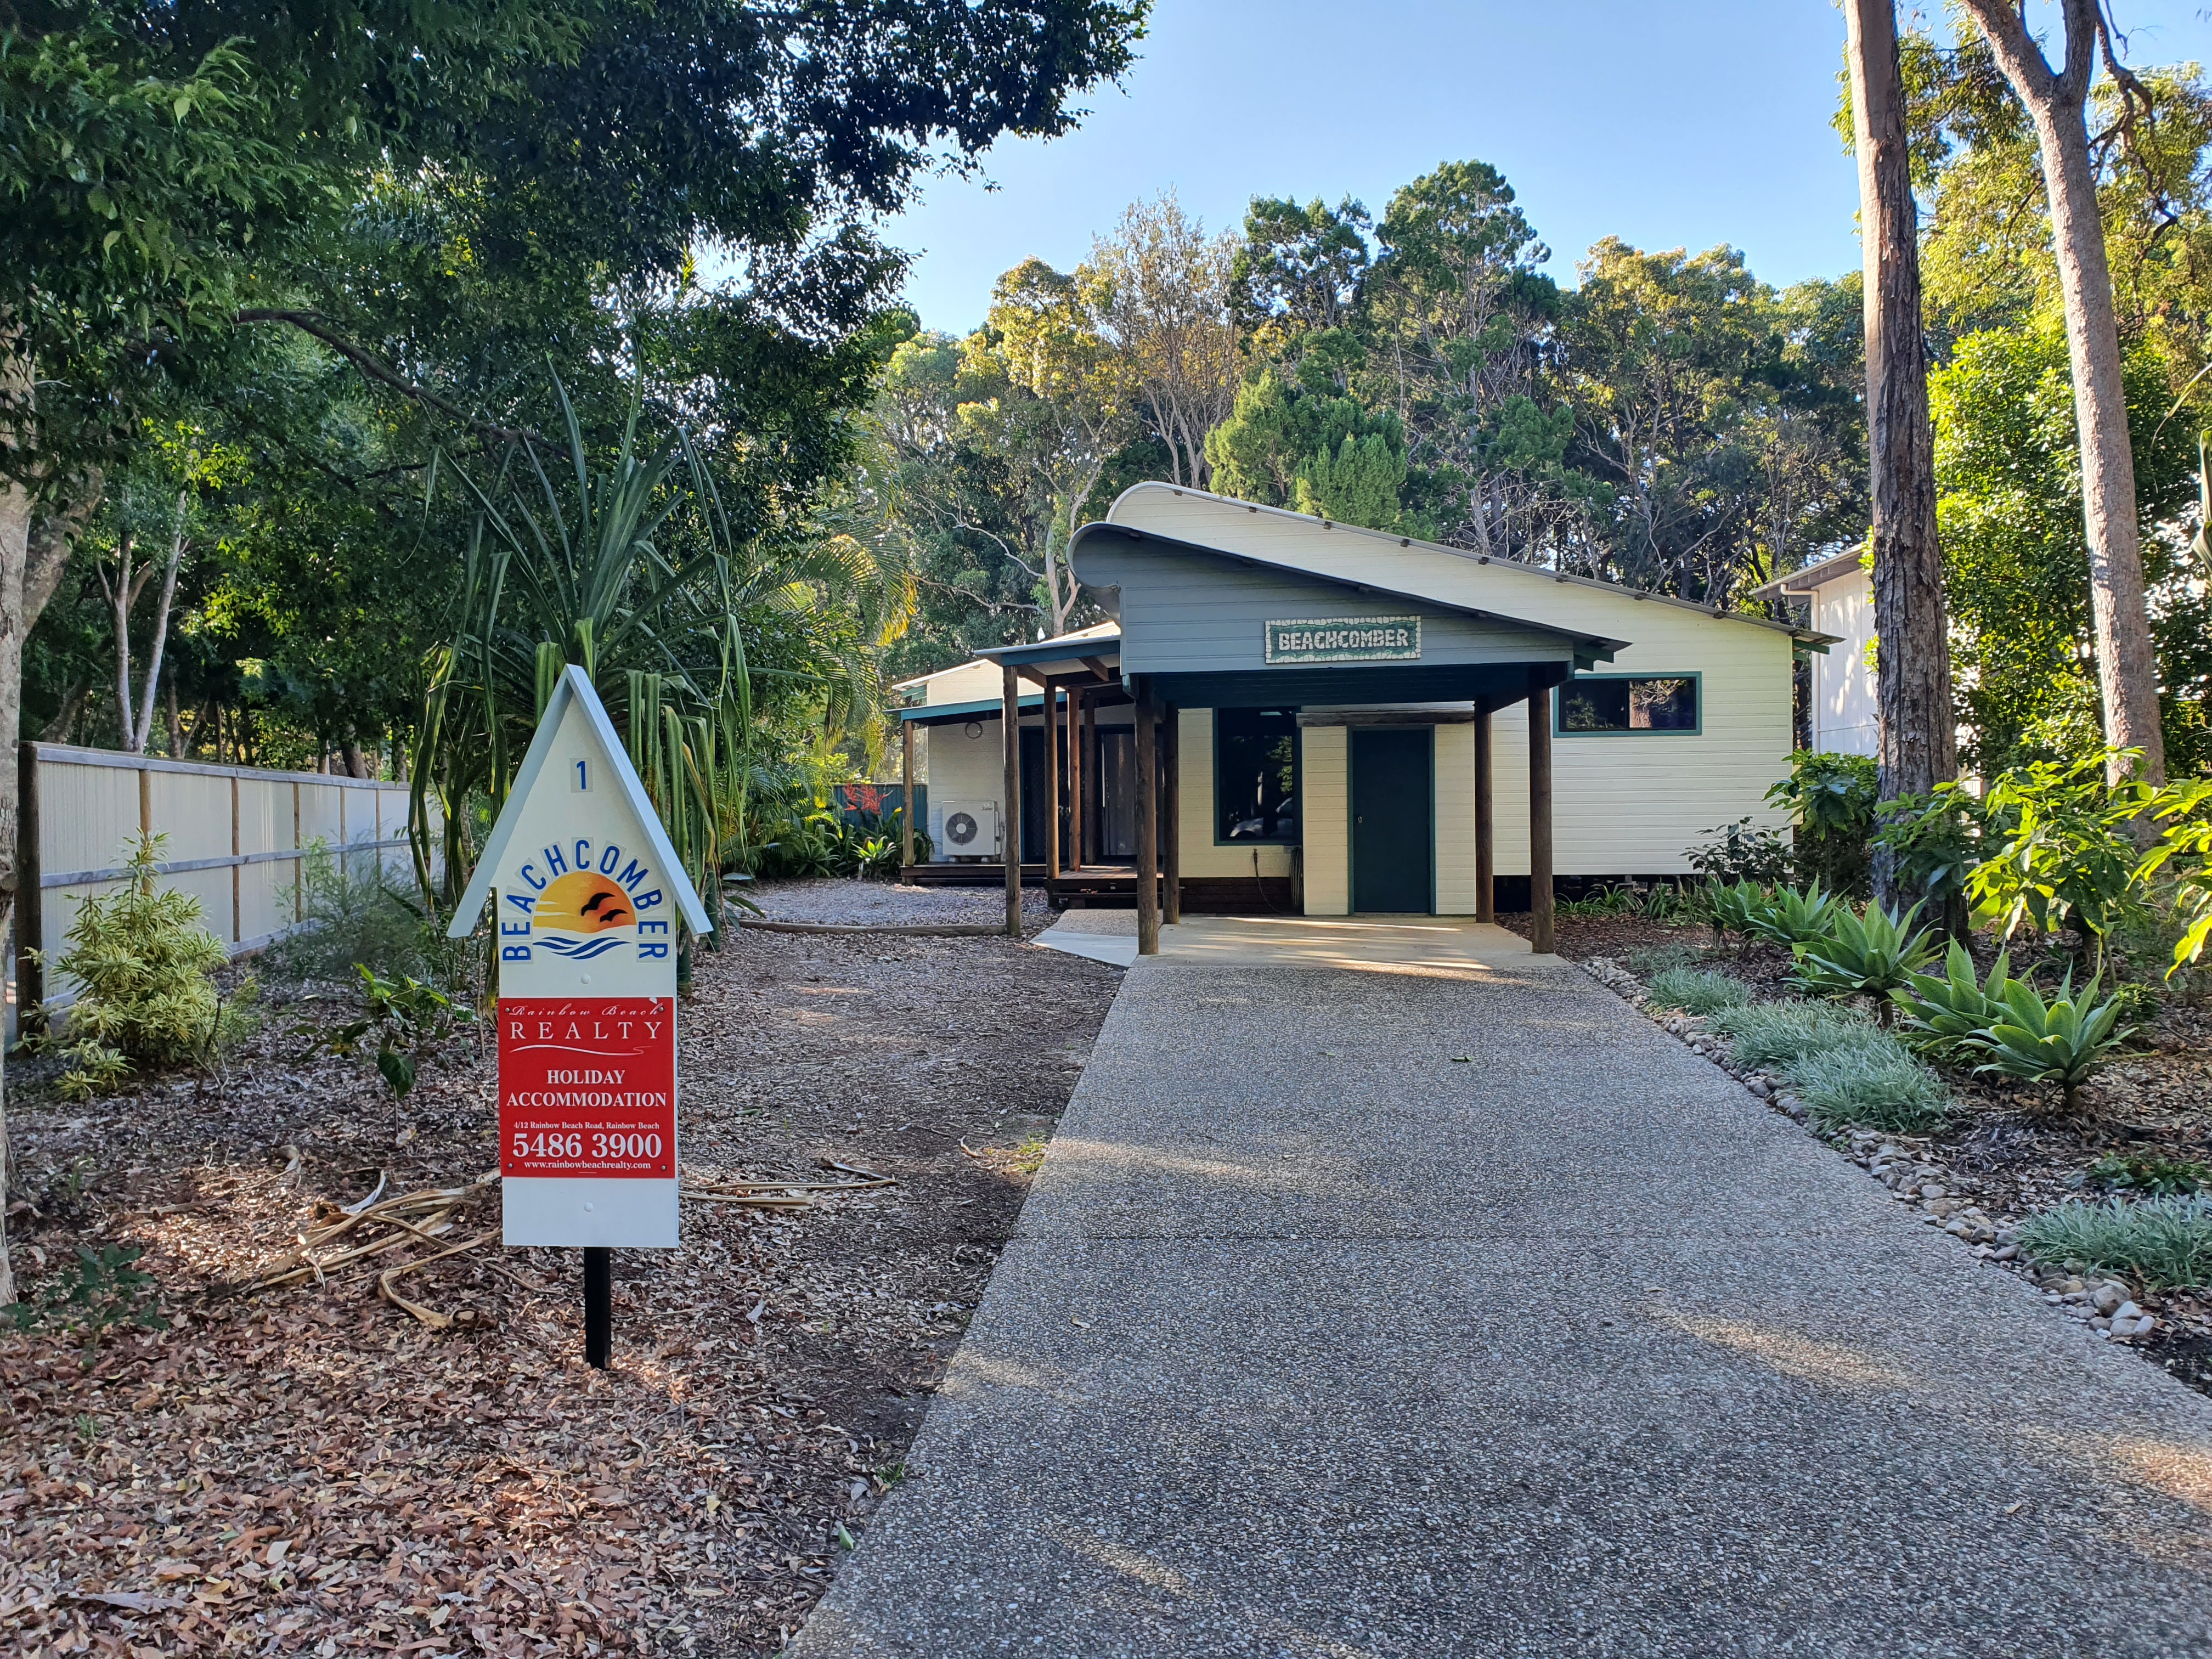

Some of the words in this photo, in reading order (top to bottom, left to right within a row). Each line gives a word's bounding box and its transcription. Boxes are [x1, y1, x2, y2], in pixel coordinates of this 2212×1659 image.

[1279, 629, 1408, 651] BEACHCOMBER
[576, 760, 586, 790] 1
[501, 839, 668, 961] BEACHCOMBER
[509, 1003, 590, 1015] Rainbow
[601, 1002, 663, 1015] Beach
[510, 1022, 662, 1040] REALTY
[546, 1070, 625, 1084] HOLIDAY
[506, 1092, 667, 1107] ACCOMMODATION
[585, 1121, 604, 1130] Road,
[512, 1132, 582, 1158] 5486
[591, 1133, 662, 1158] 3900
[524, 1160, 651, 1170] www.rainbowbeachrealty.com
